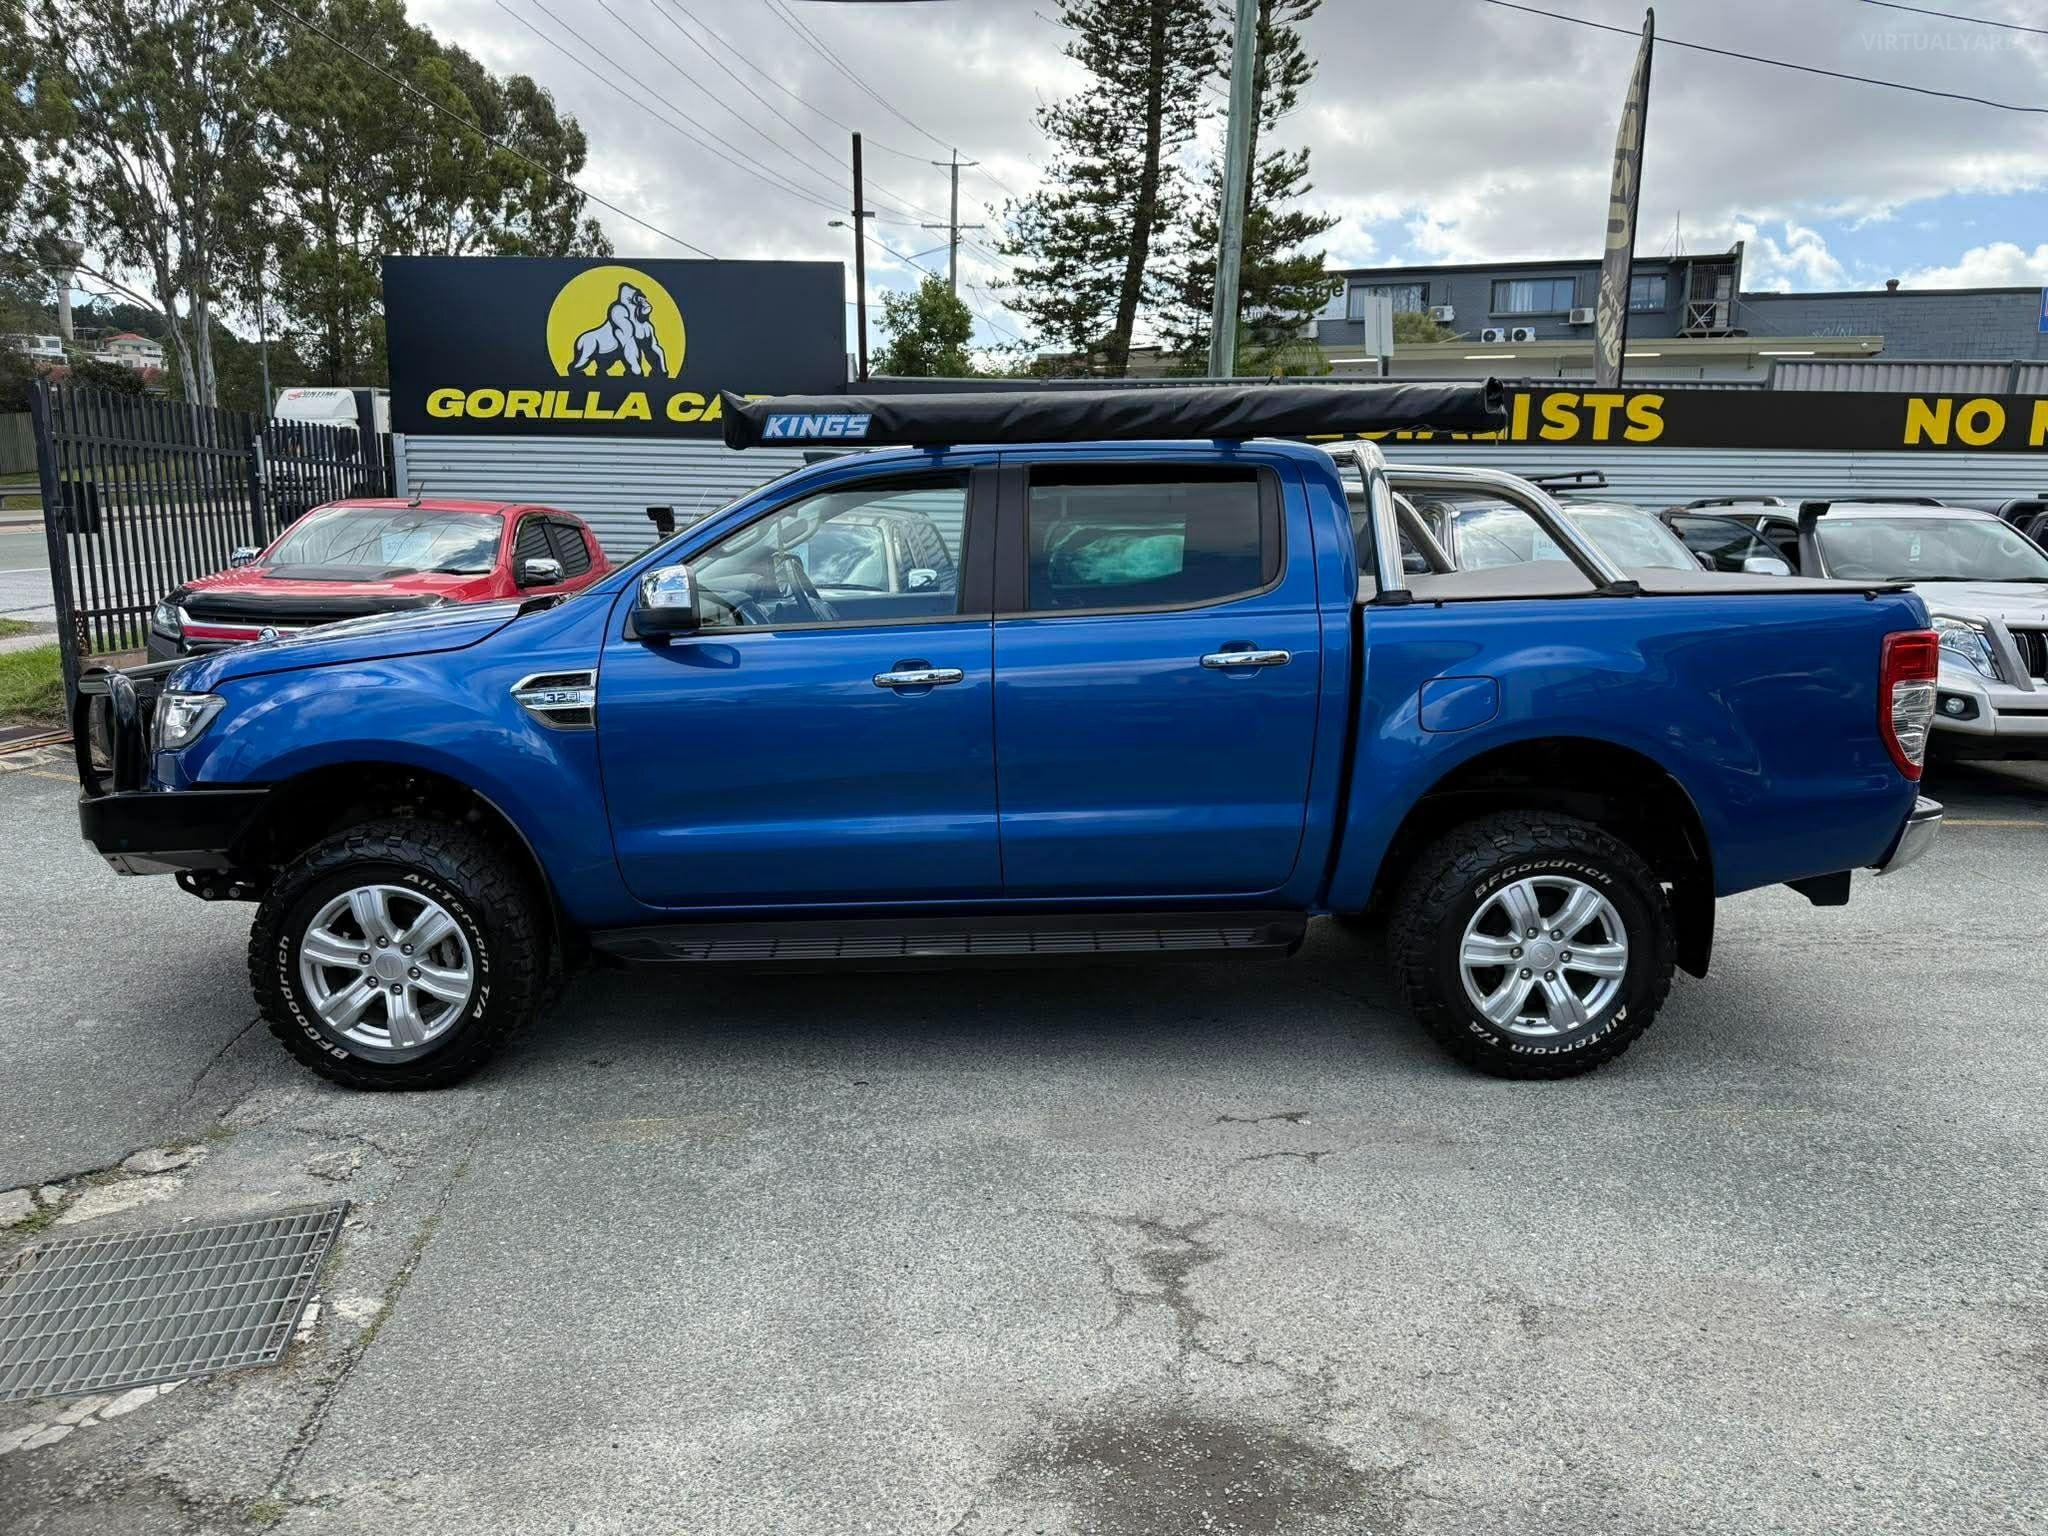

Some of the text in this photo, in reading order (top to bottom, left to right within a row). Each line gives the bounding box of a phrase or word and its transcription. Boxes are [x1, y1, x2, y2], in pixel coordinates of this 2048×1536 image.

[426, 388, 653, 421] GORILLA
[764, 416, 869, 437] KINGS
[1903, 398, 2006, 446] NO
[1473, 858, 1613, 899] BFGoodrich
[403, 873, 489, 973] All-Terrain
[277, 935, 350, 1060] BFGoodrich
[1510, 1004, 1628, 1056] All-Terrain
